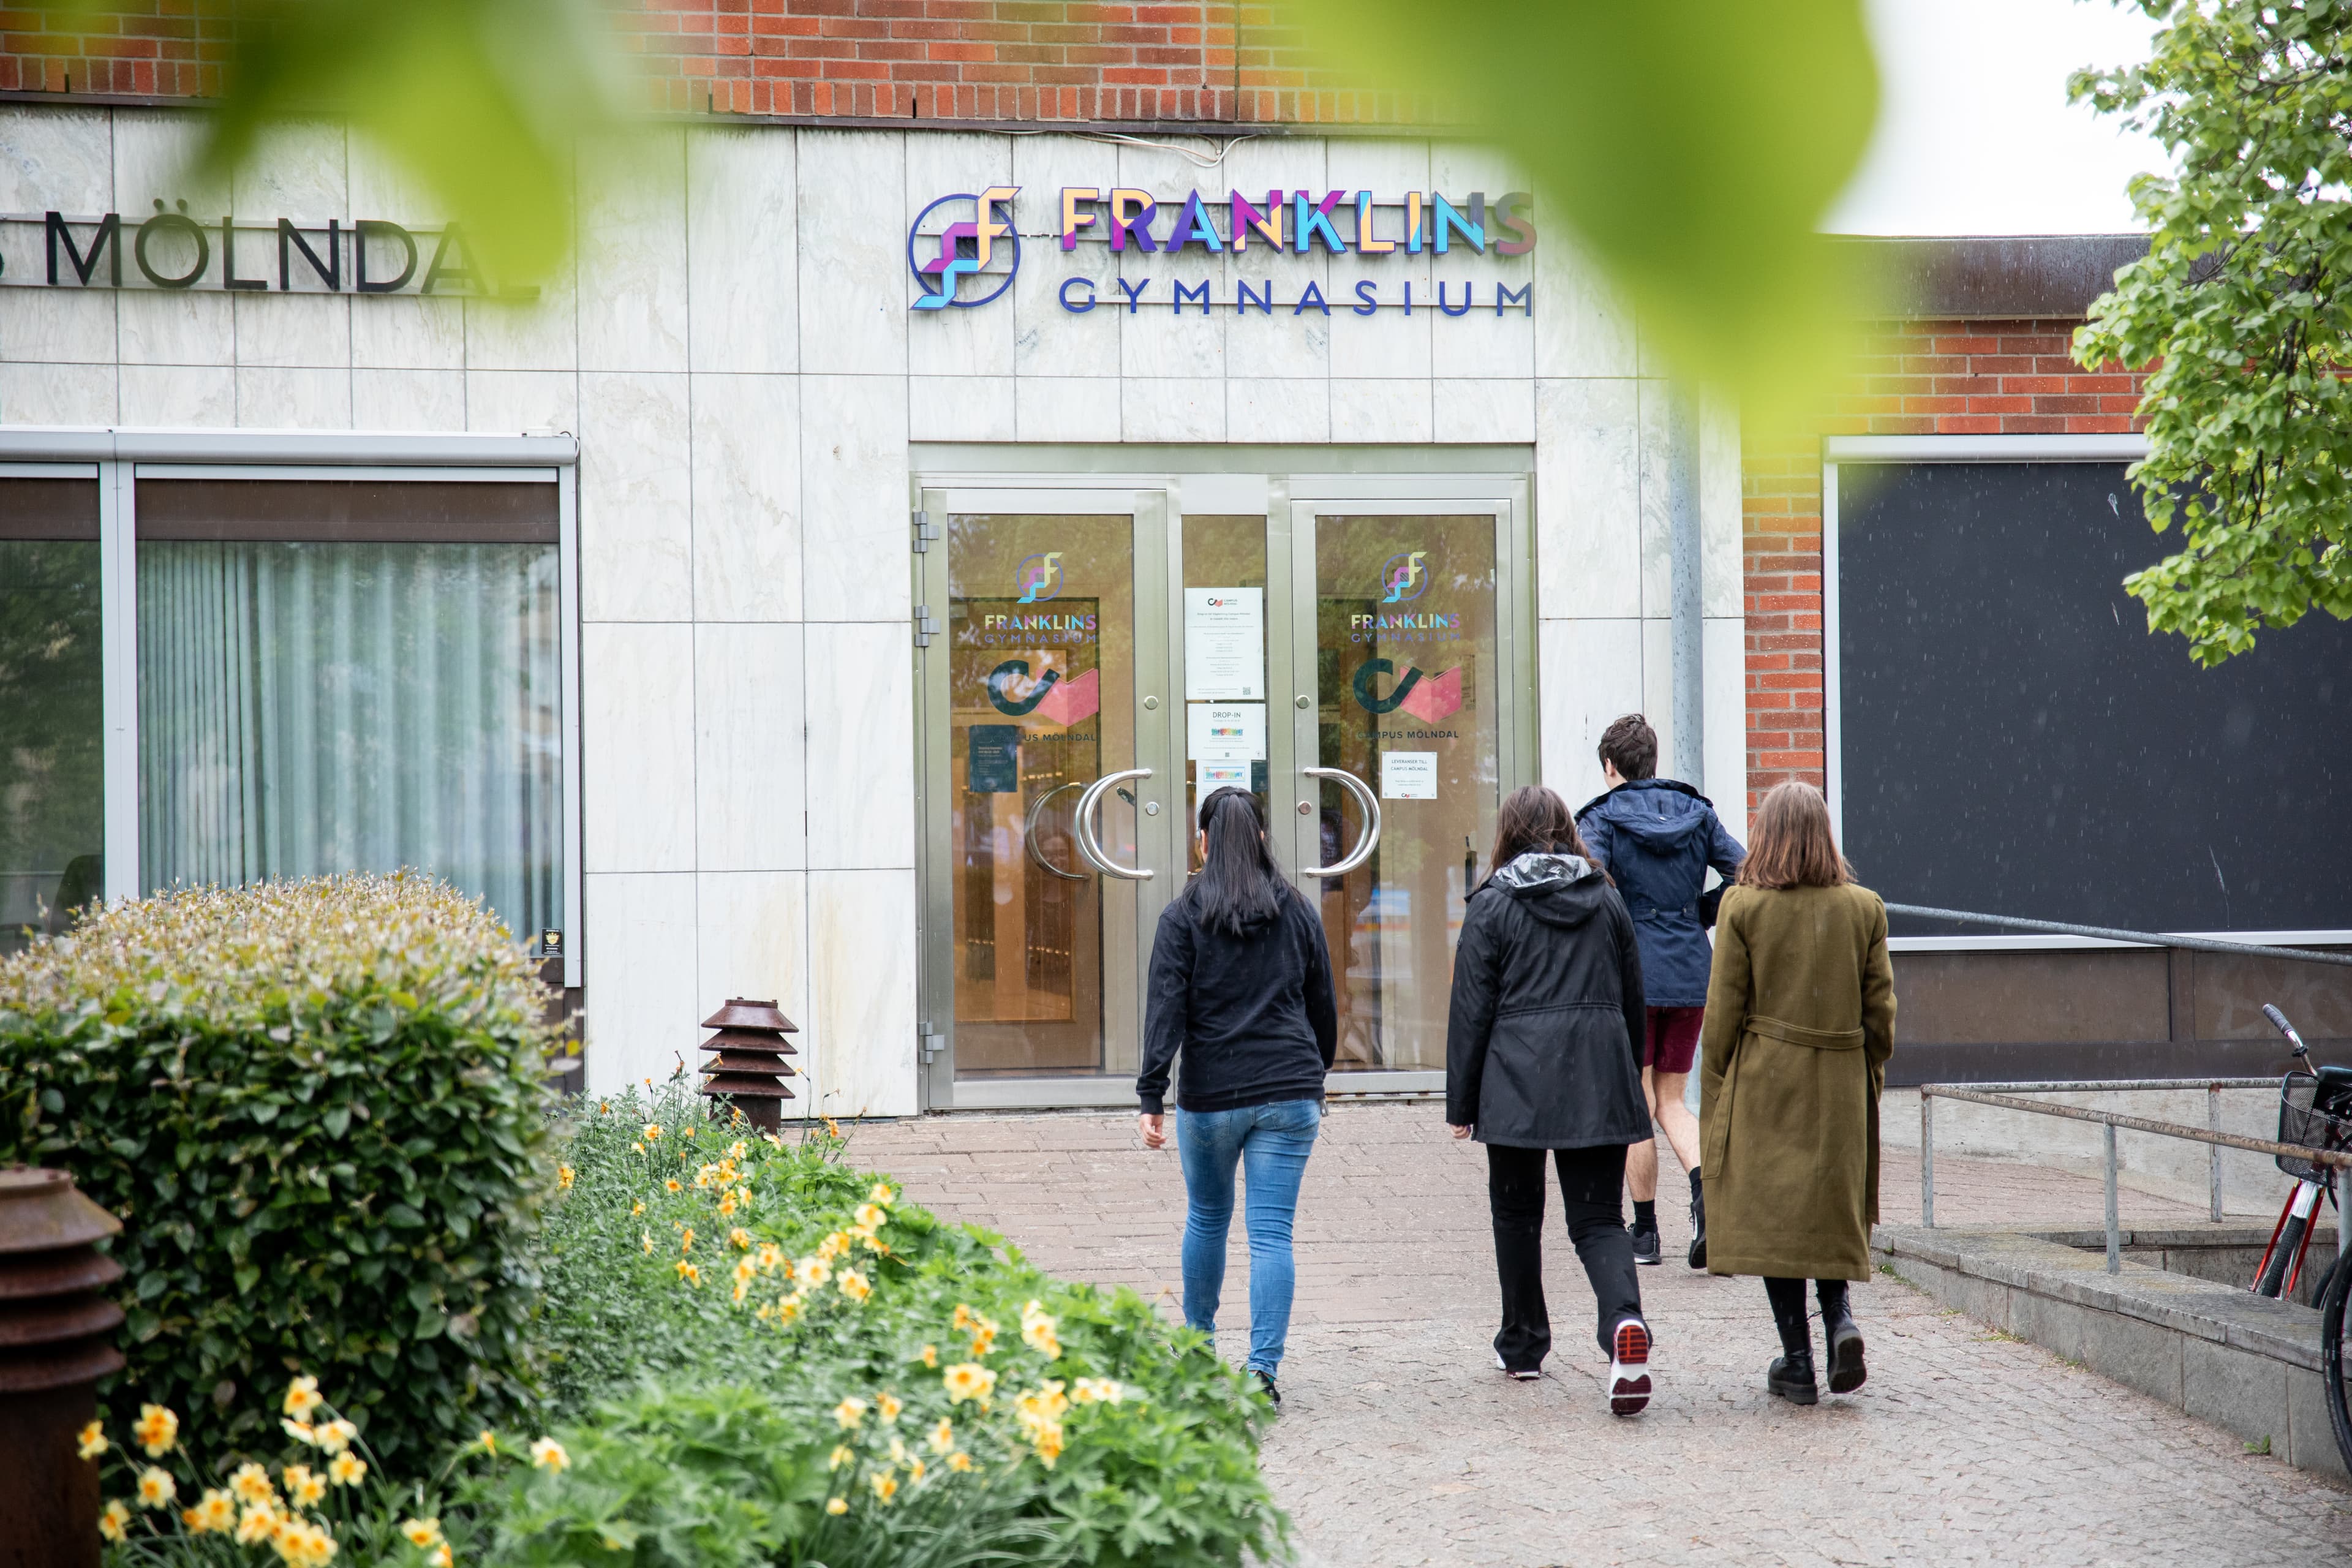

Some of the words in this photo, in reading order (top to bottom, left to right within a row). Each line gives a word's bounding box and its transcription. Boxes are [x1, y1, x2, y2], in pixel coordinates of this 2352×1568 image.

[1060, 186, 1538, 257] FRANKLINS
[1058, 276, 1533, 317] GYMNASIUM
[984, 614, 1096, 630] FRANKLINS
[1351, 613, 1461, 630] FRANKLINS
[984, 633, 1096, 644] GYMNASIUM
[1351, 632, 1461, 643] GYMNASIUM
[1042, 732, 1096, 742] MÖLNDAL
[1407, 729, 1460, 739] MÖLNDAL
